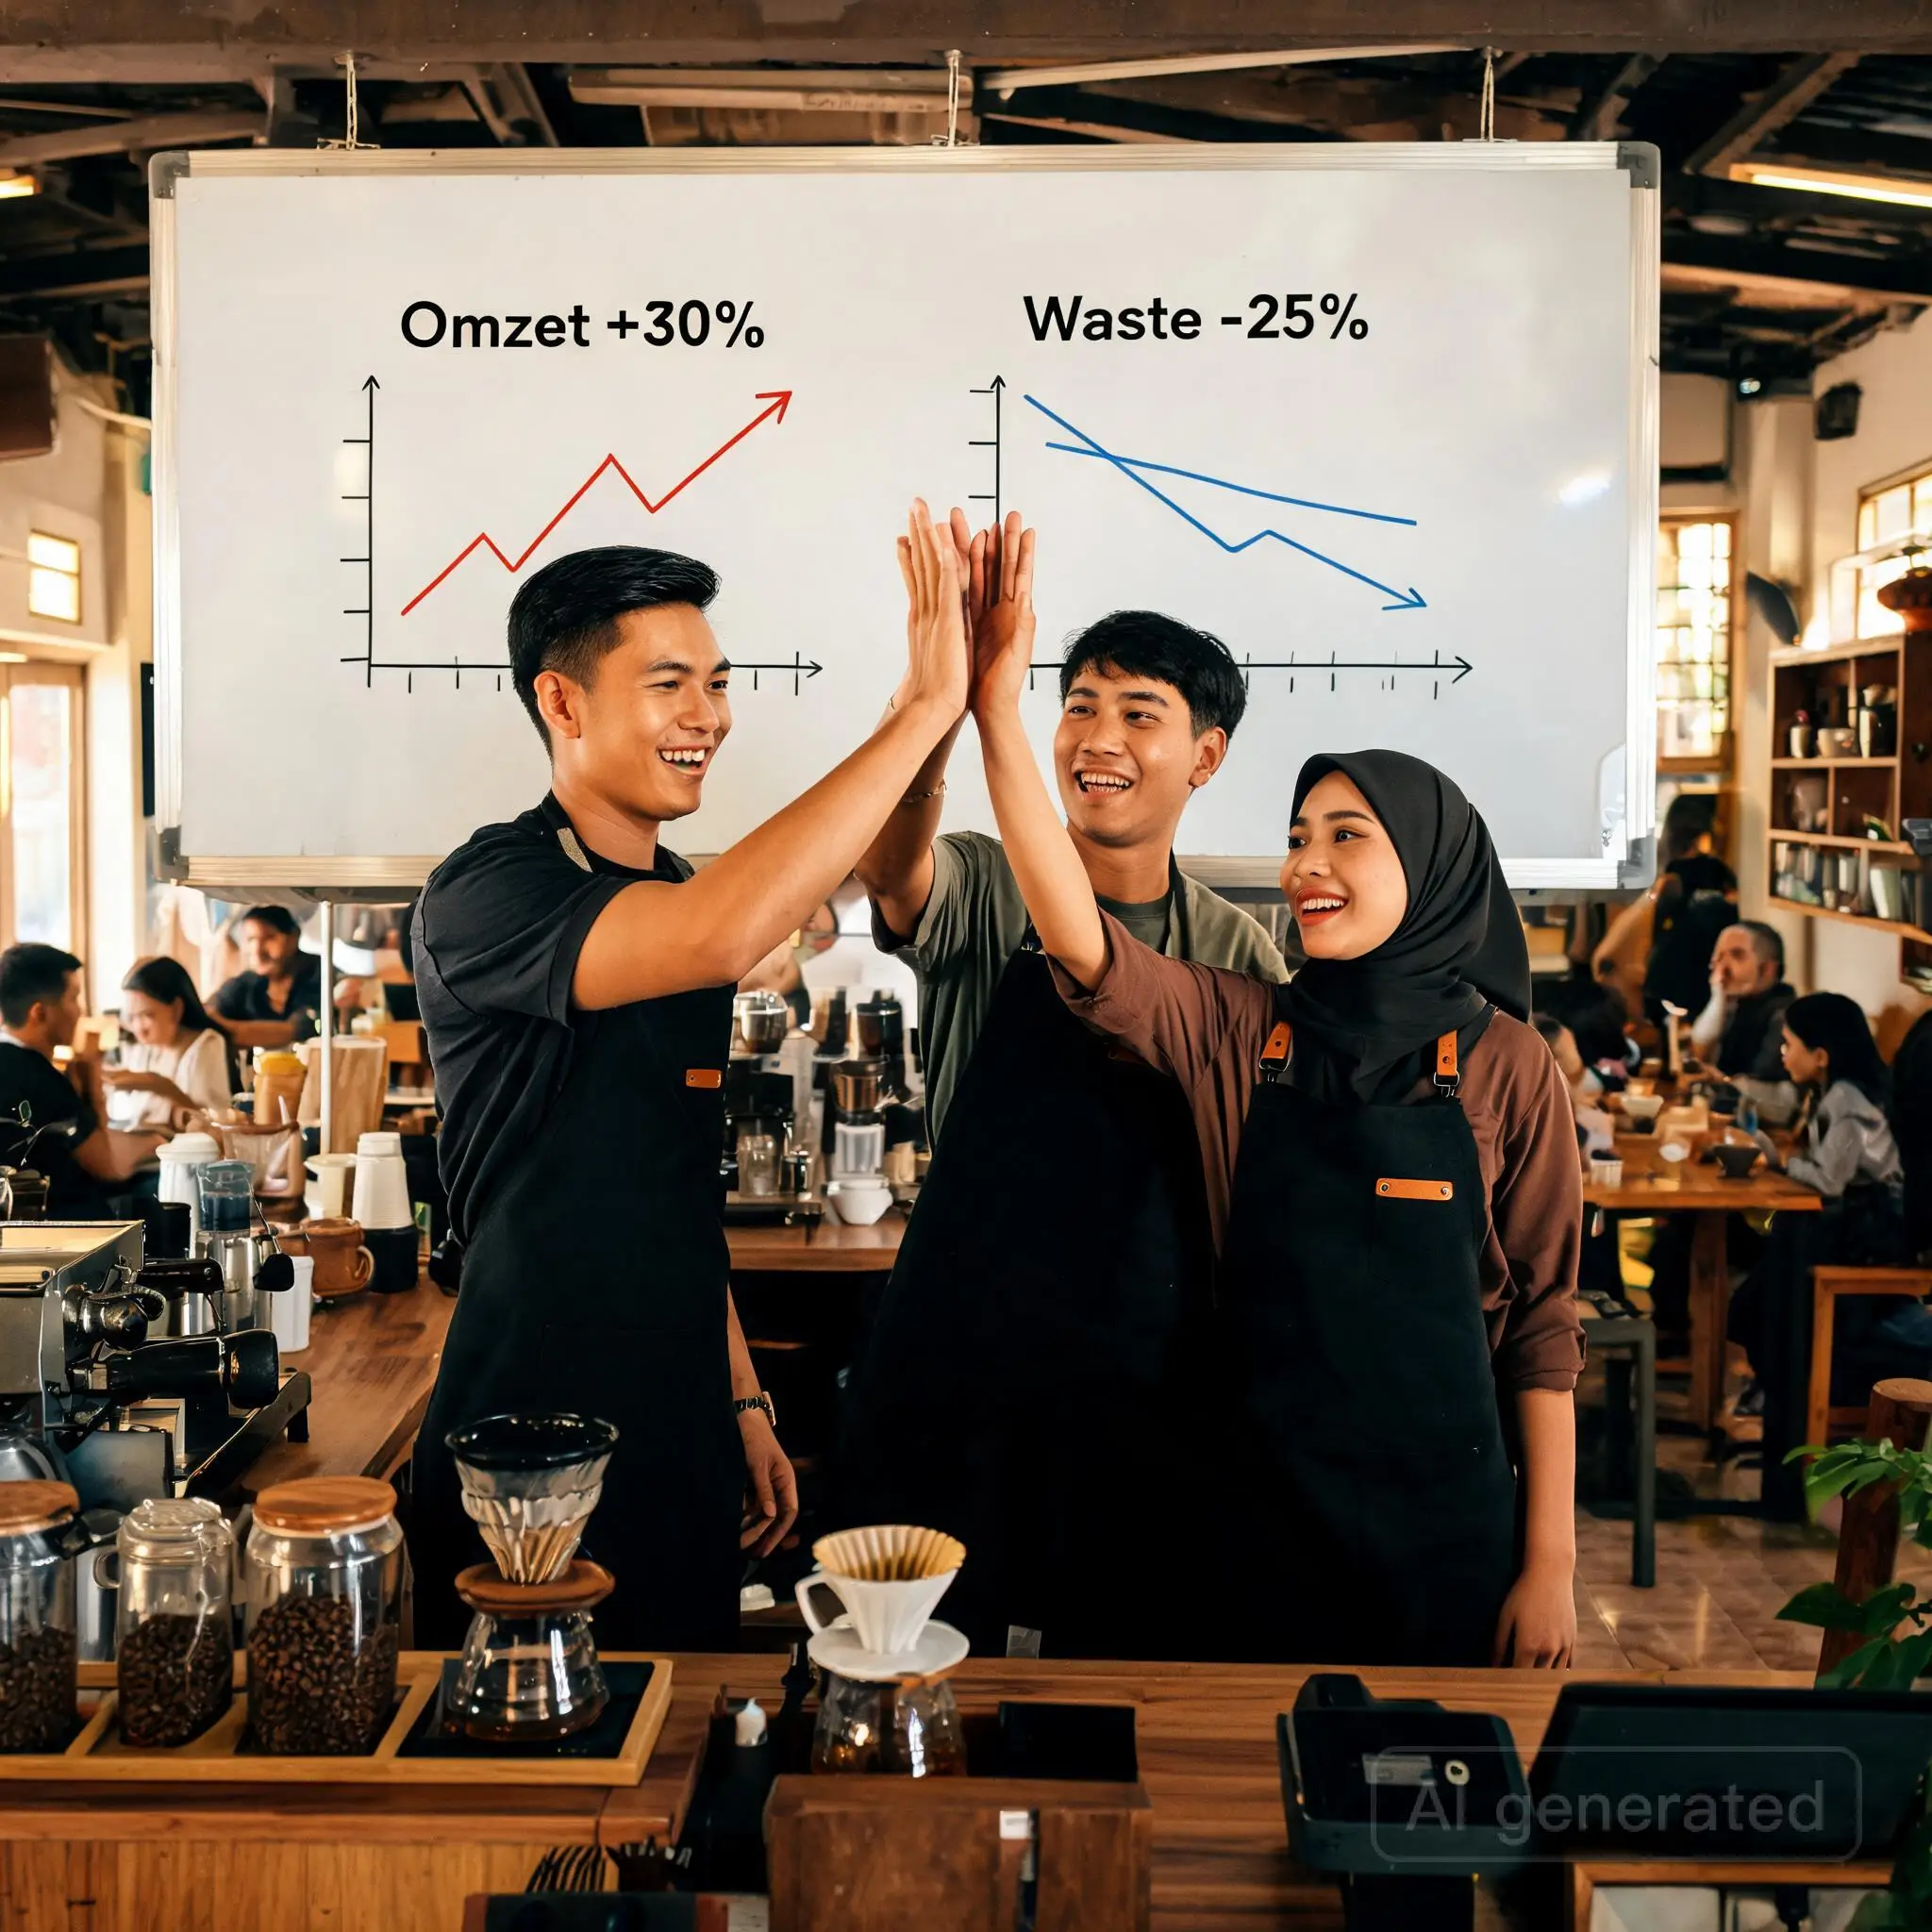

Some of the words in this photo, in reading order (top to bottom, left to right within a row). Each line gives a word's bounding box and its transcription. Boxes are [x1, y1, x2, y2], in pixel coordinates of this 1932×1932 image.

[401, 300, 591, 349] Omzet
[607, 299, 765, 349] +30%
[1024, 295, 1202, 341] Waste
[1221, 292, 1369, 341] -25%
